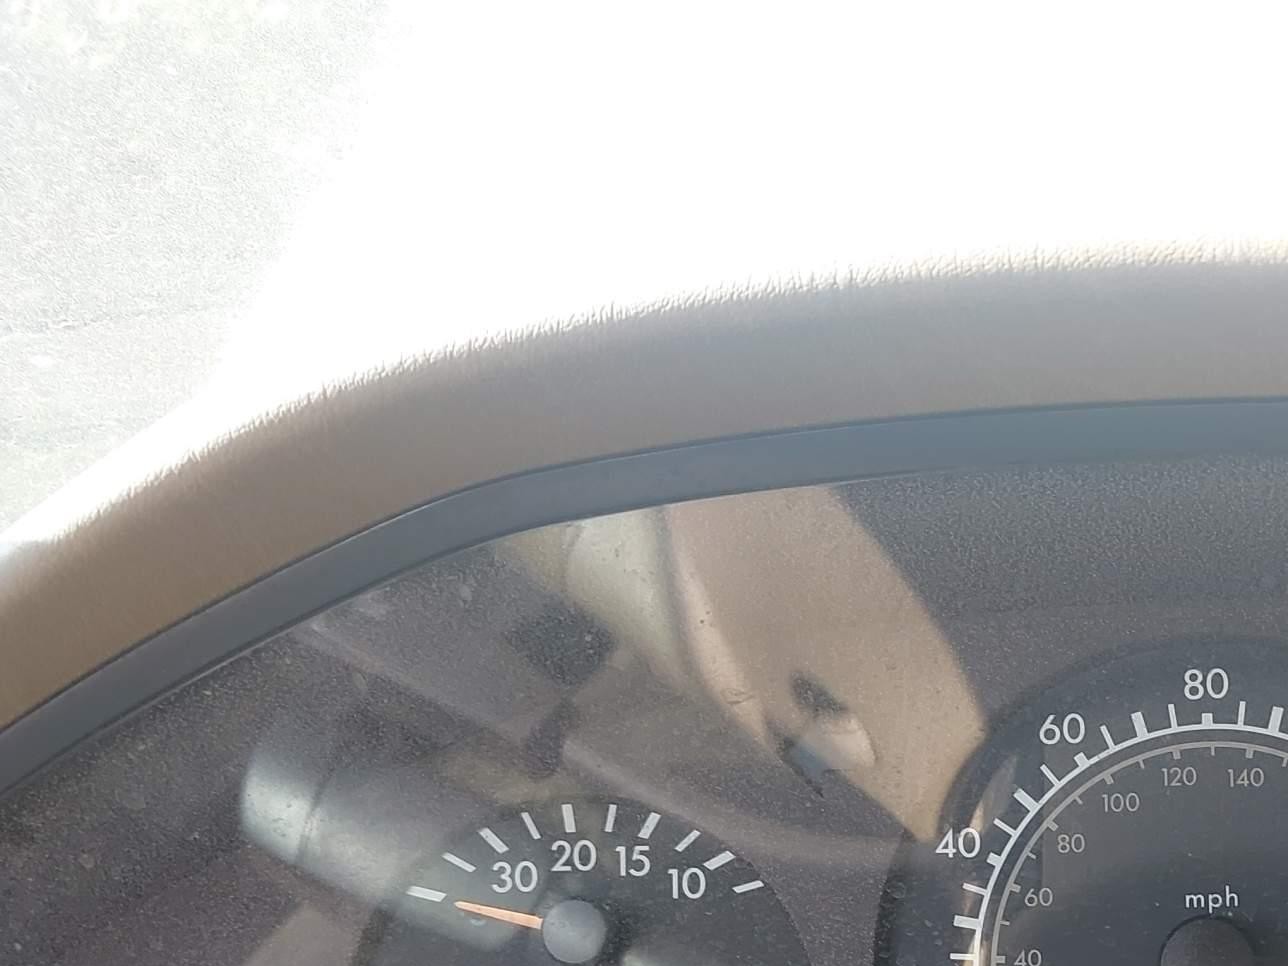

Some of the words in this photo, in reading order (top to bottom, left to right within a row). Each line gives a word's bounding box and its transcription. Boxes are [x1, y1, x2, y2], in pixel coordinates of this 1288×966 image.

[1183, 669, 1229, 699] 80
[1039, 712, 1086, 745] 60
[1161, 767, 1197, 787] 120
[1227, 768, 1265, 788] 140
[1101, 792, 1140, 812] 100
[551, 840, 597, 872] 20
[935, 827, 980, 859] 40
[1056, 833, 1085, 854] 80
[616, 845, 650, 876] 15
[491, 861, 537, 893] 30
[668, 867, 706, 899] 10
[1024, 886, 1053, 907] 60
[1184, 886, 1239, 913] mph
